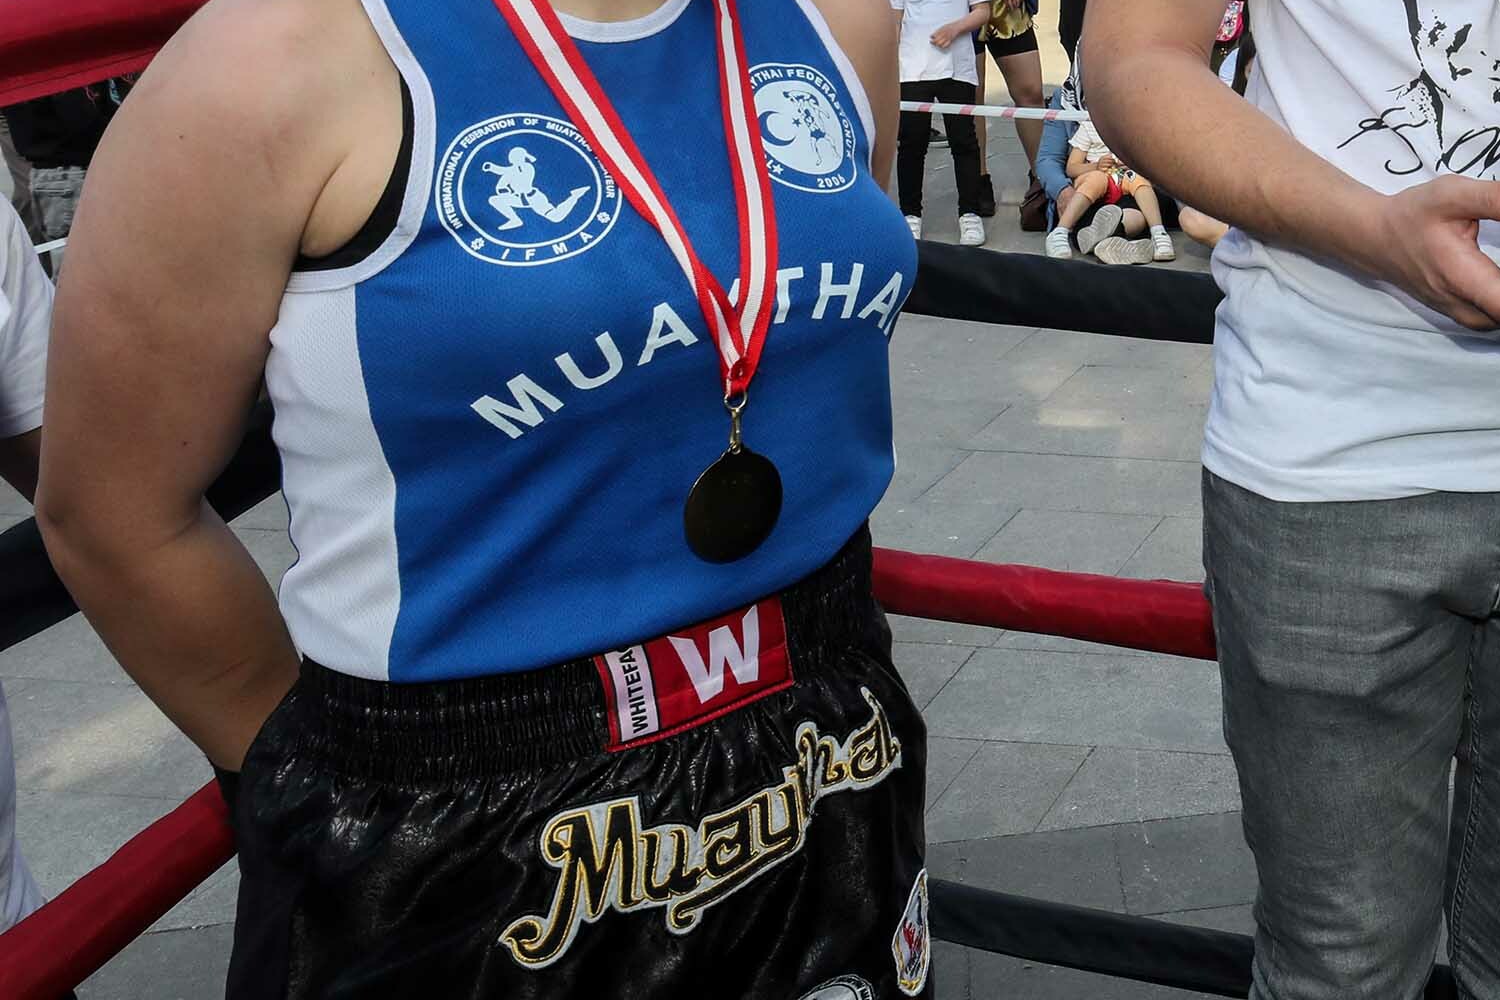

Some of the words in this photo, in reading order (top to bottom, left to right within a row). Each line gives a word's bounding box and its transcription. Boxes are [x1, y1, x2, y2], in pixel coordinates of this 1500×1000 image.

[442, 150, 464, 230] INTERNATIONAL
[460, 118, 516, 149] FEDERATION
[523, 118, 539, 126] OF
[816, 174, 846, 188] 2006
[471, 262, 912, 440] MUATHA
[667, 604, 760, 705] W
